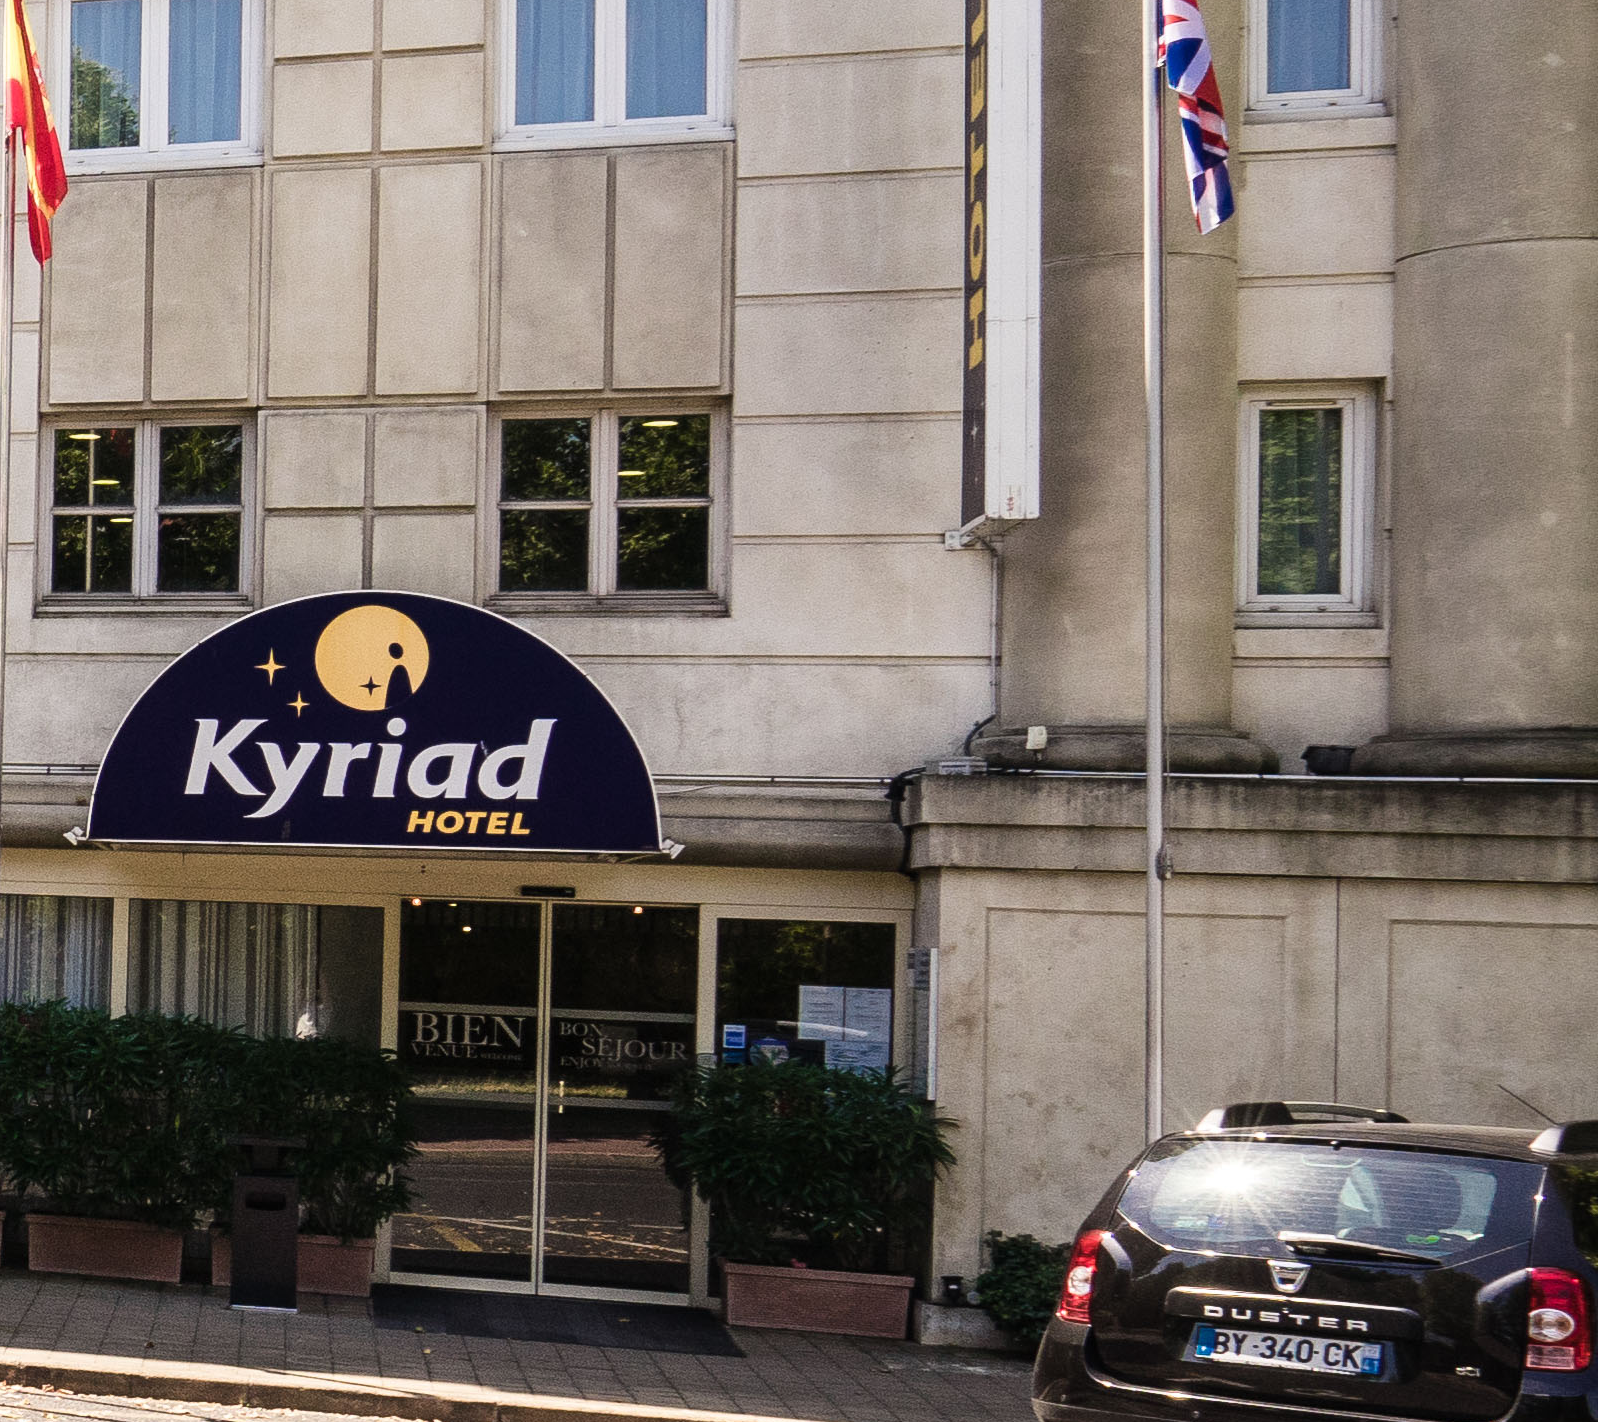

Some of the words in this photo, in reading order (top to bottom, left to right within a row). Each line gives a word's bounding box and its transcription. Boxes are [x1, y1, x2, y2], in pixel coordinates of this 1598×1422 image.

[183, 717, 558, 819] Kyriad
[406, 810, 531, 835] HOTEL
[412, 1012, 526, 1048] BIEN
[560, 1022, 604, 1037] BON
[411, 1042, 479, 1059] VENUE
[560, 1056, 603, 1069] ENJOY
[1204, 1305, 1369, 1332] DUSTER
